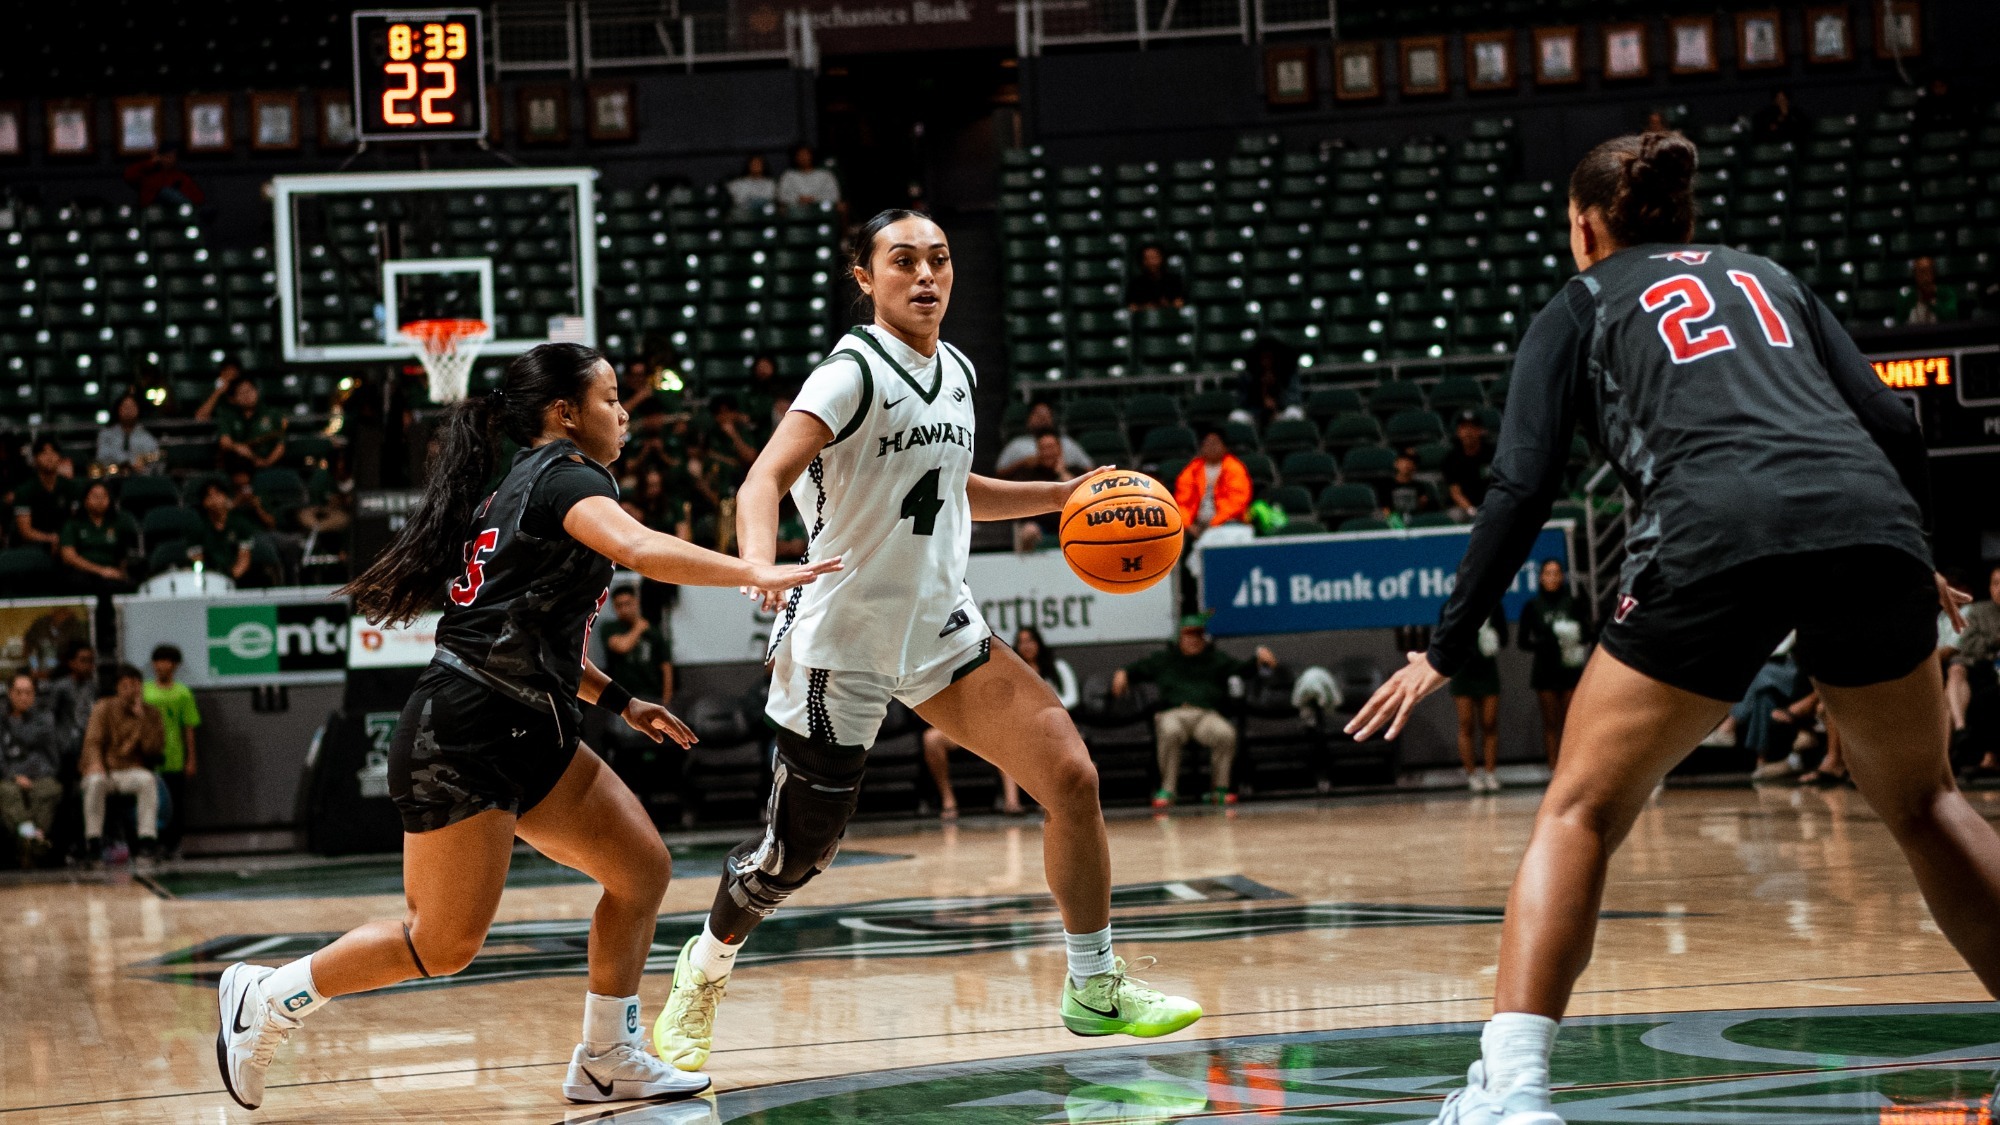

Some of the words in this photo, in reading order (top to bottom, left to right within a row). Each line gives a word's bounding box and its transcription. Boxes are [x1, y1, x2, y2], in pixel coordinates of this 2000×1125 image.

[913, 1, 970, 24] Bank
[387, 22, 467, 61] 8:33
[382, 62, 456, 125] 22
[1639, 269, 1794, 364] 21
[1870, 357, 1951, 388] WAI'I
[900, 466, 945, 536] 4
[1090, 476, 1150, 495] NCAA
[1086, 505, 1168, 529] Wilson
[1121, 555, 1143, 573] H
[1289, 571, 1374, 605] Bank
[1378, 567, 1415, 600] of
[982, 591, 1095, 631] ertiser
